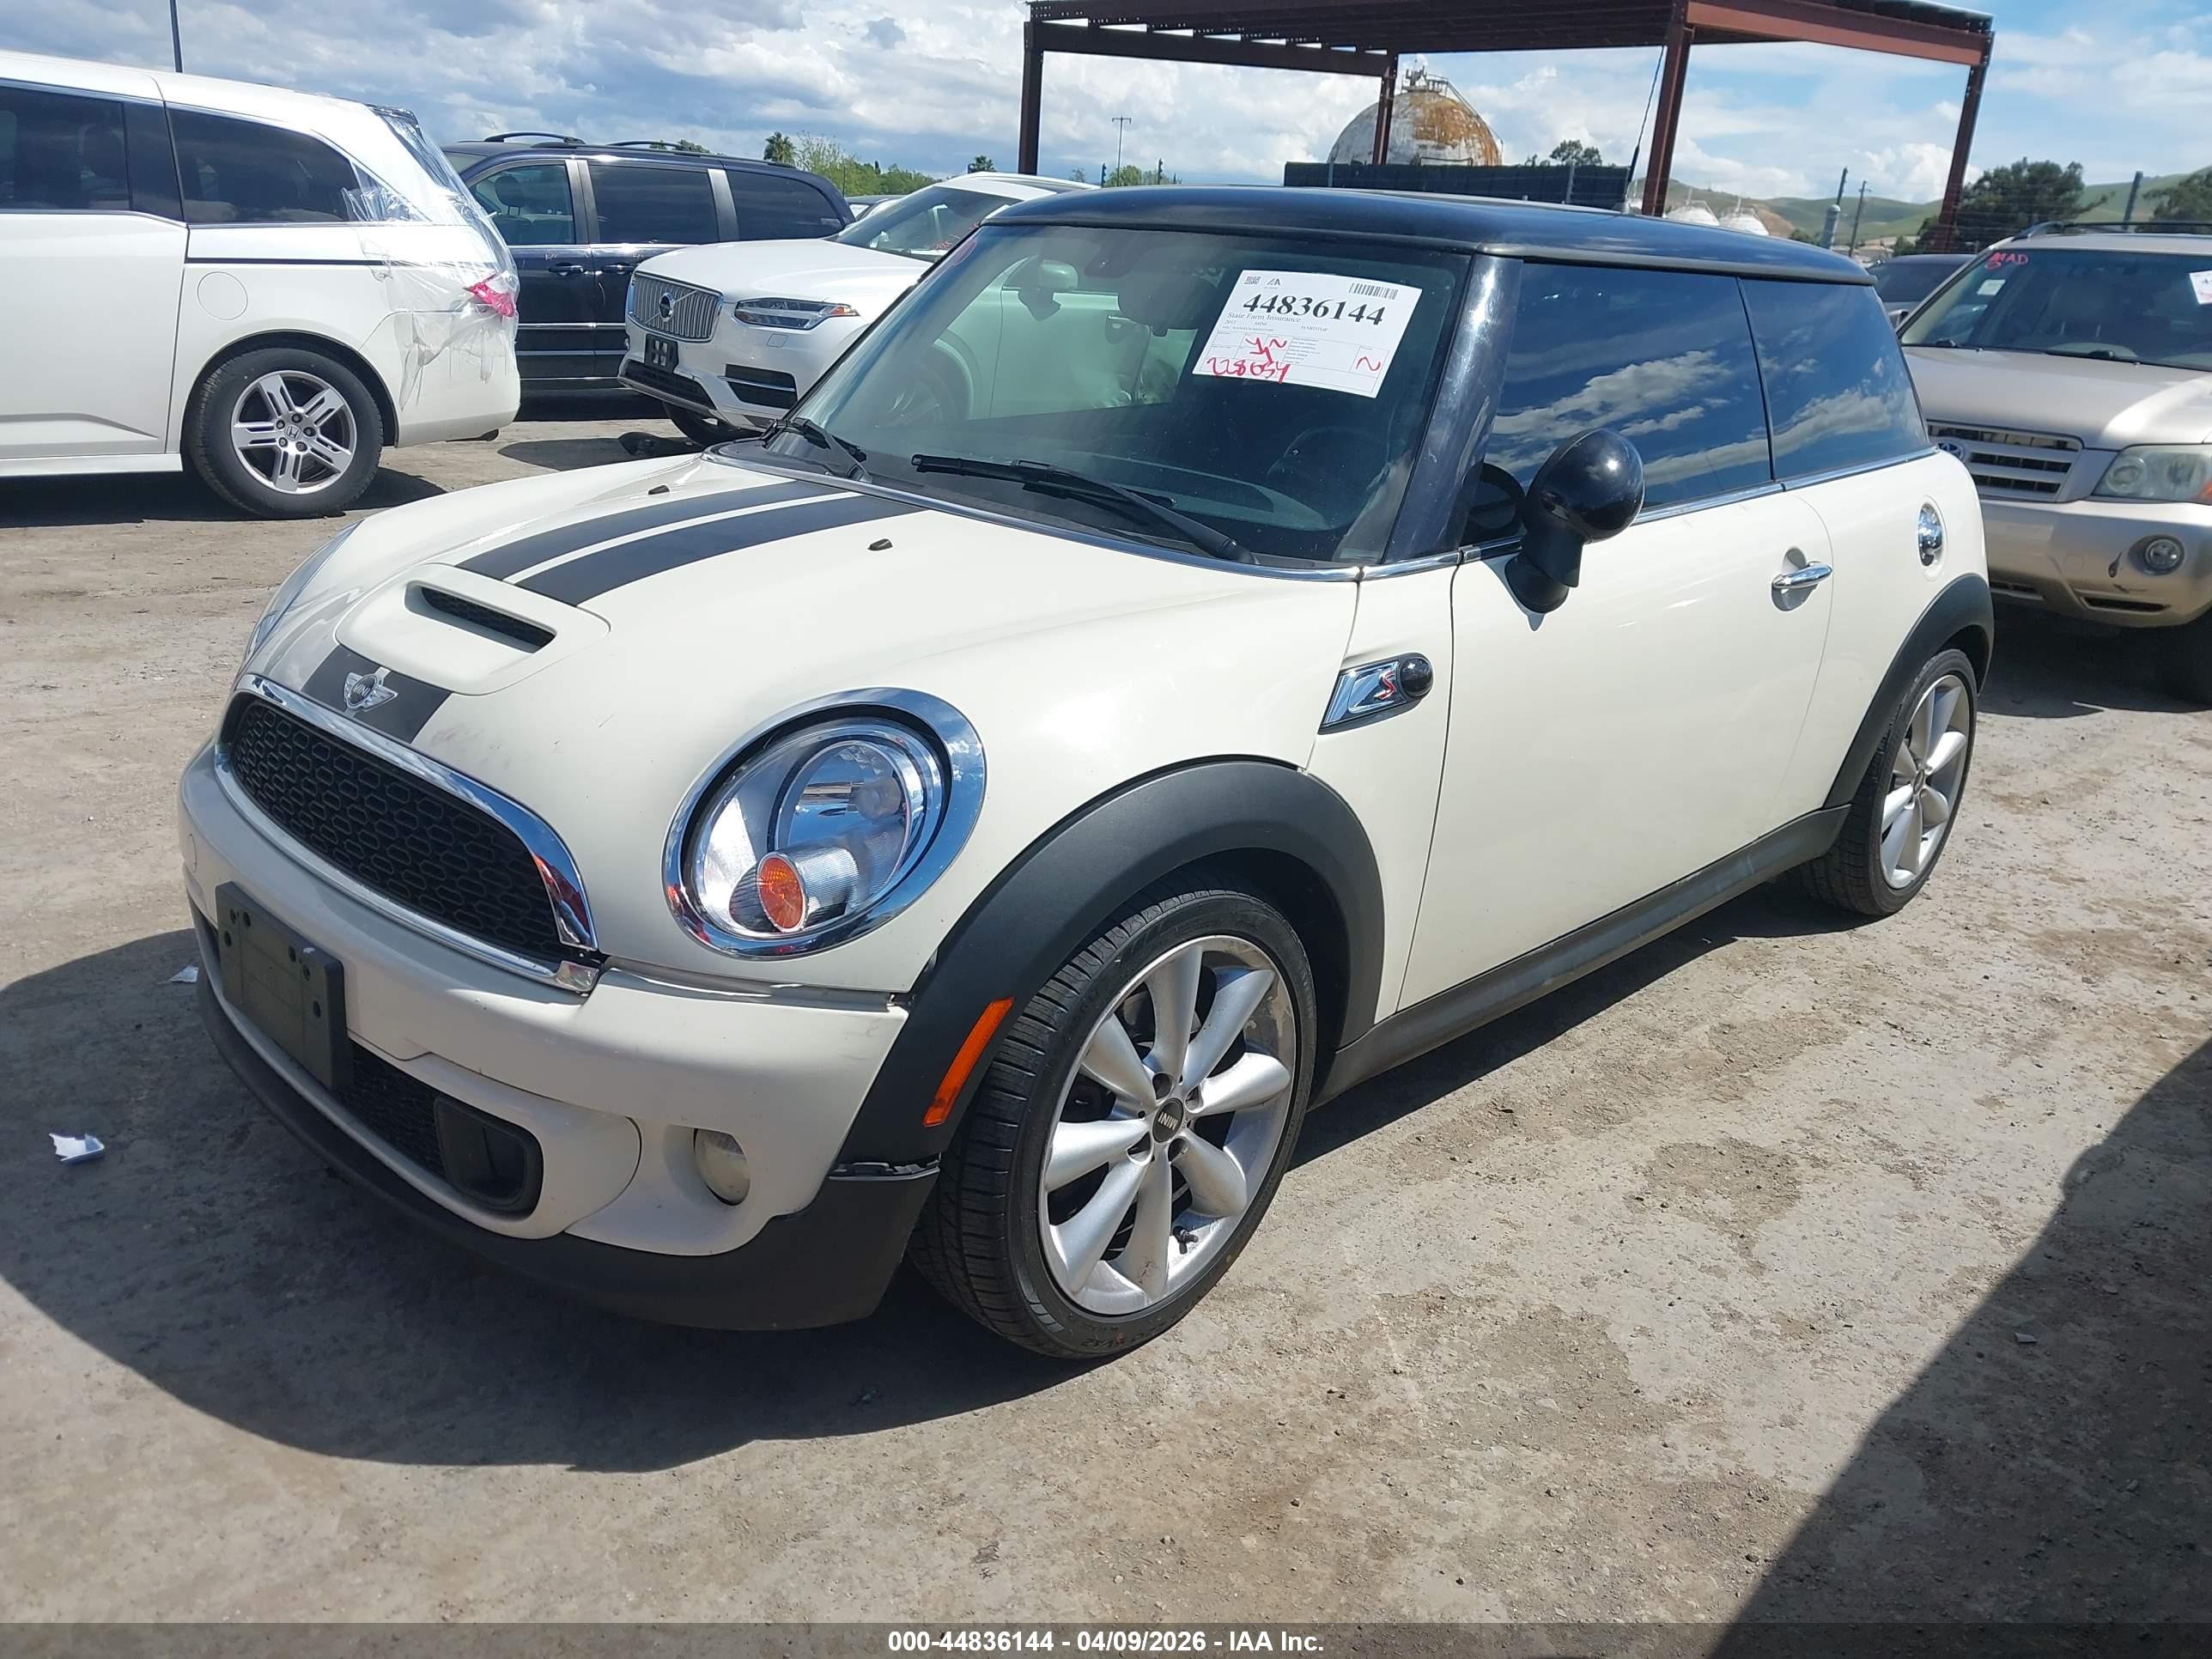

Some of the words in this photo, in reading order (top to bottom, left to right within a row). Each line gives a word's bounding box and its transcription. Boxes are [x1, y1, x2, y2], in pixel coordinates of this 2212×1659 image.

[1243, 293, 1386, 326] 44836144
[1267, 313, 1302, 323] Insurance
[353, 682, 371, 697] MINI
[1157, 1110, 1179, 1132] MINI
